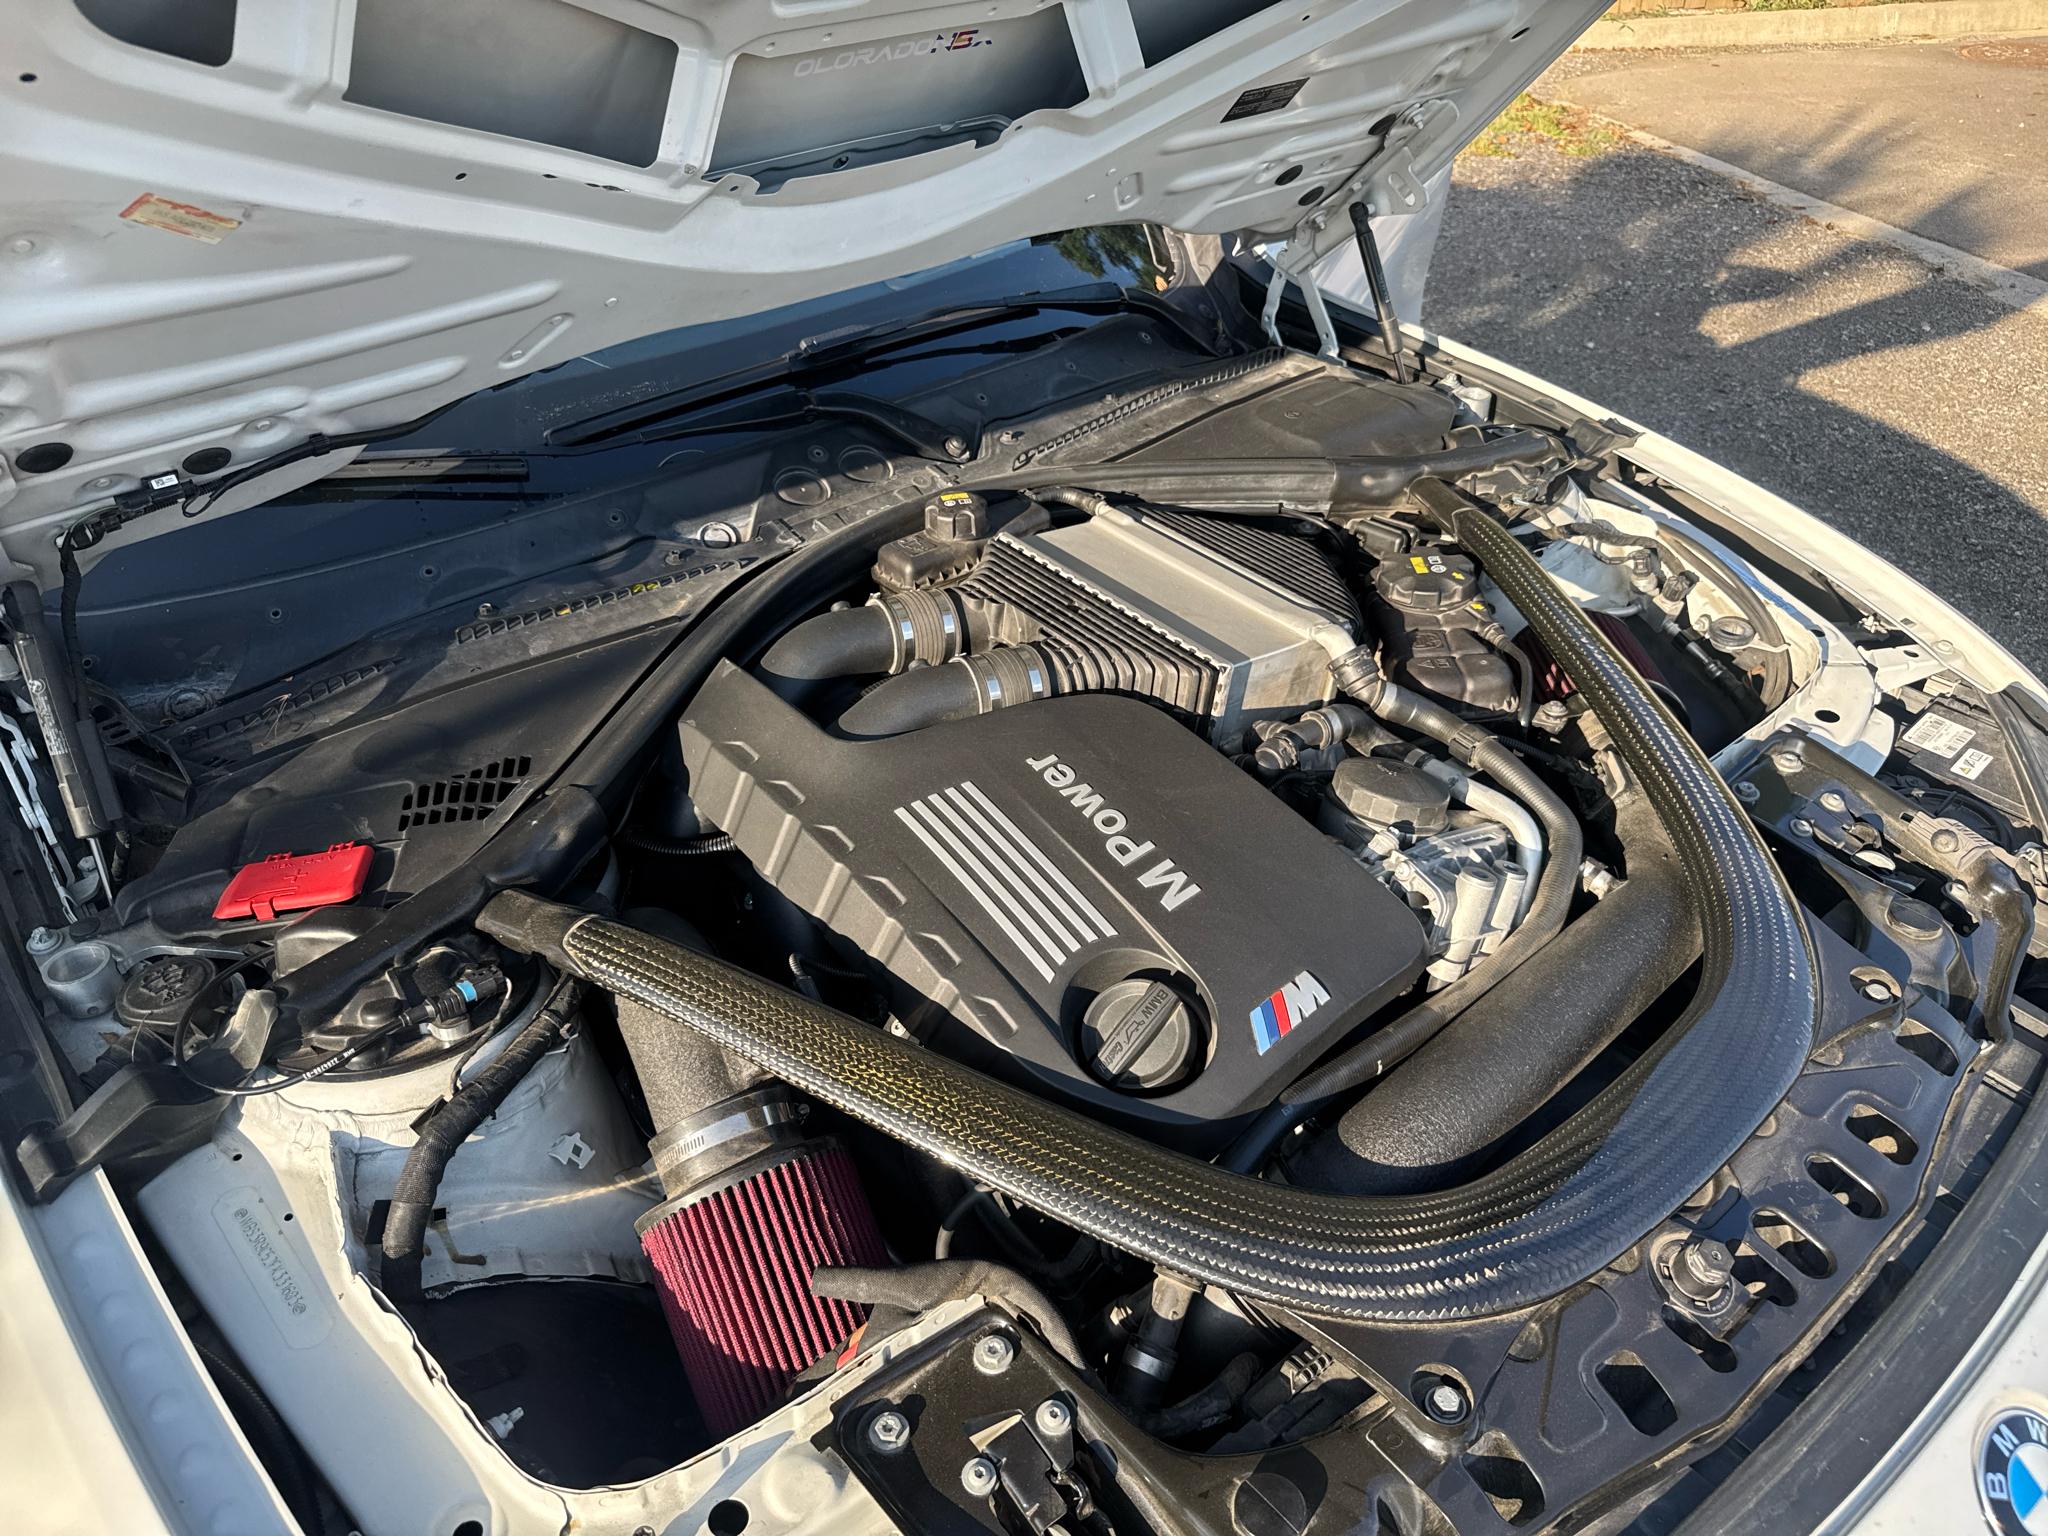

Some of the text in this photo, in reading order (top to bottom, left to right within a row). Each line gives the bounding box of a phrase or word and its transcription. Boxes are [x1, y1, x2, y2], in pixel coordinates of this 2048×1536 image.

[1025, 753, 1203, 912] M Power
[1141, 988, 1169, 1019] BMW
[1985, 1416, 2048, 1500] BMW
